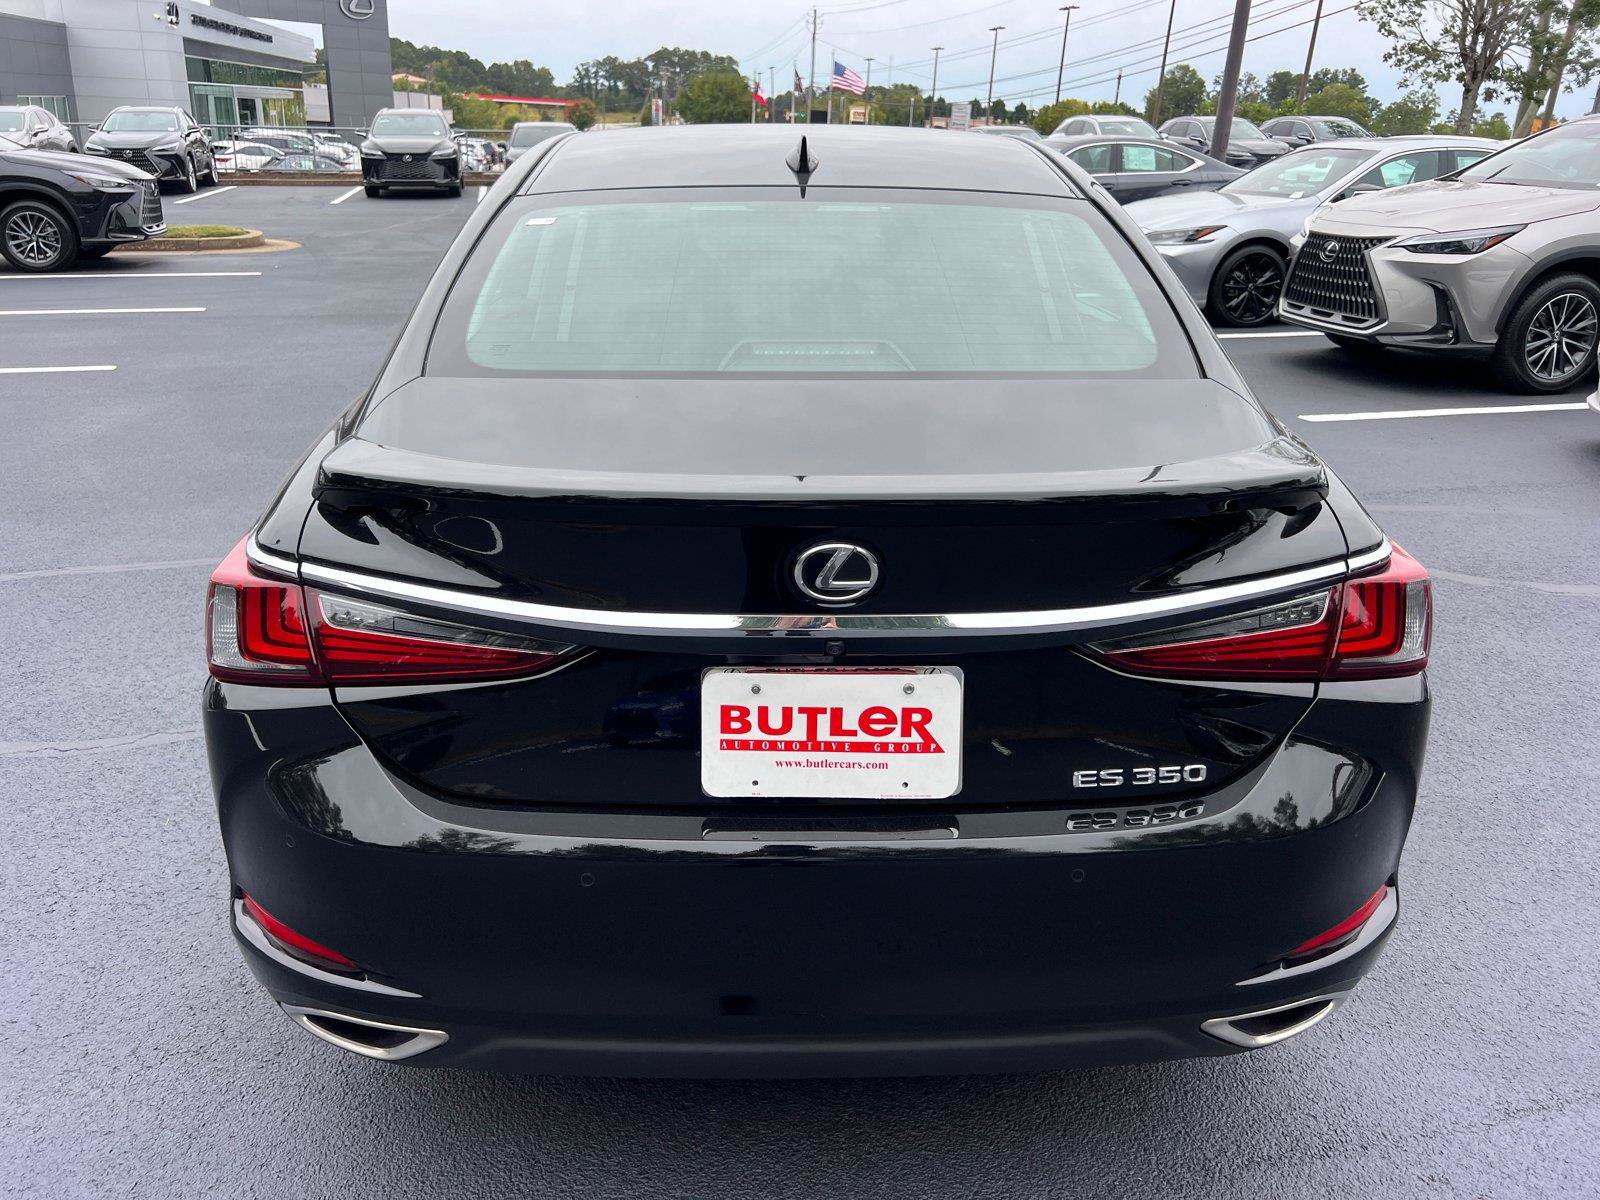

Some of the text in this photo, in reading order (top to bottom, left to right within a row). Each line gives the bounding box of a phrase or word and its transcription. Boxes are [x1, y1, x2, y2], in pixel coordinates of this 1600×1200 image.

[720, 740, 939, 753] AUTOMOTIVE GROUP
[775, 758, 889, 771] www.butlercars.com
[1073, 764, 1207, 787] ES 350
